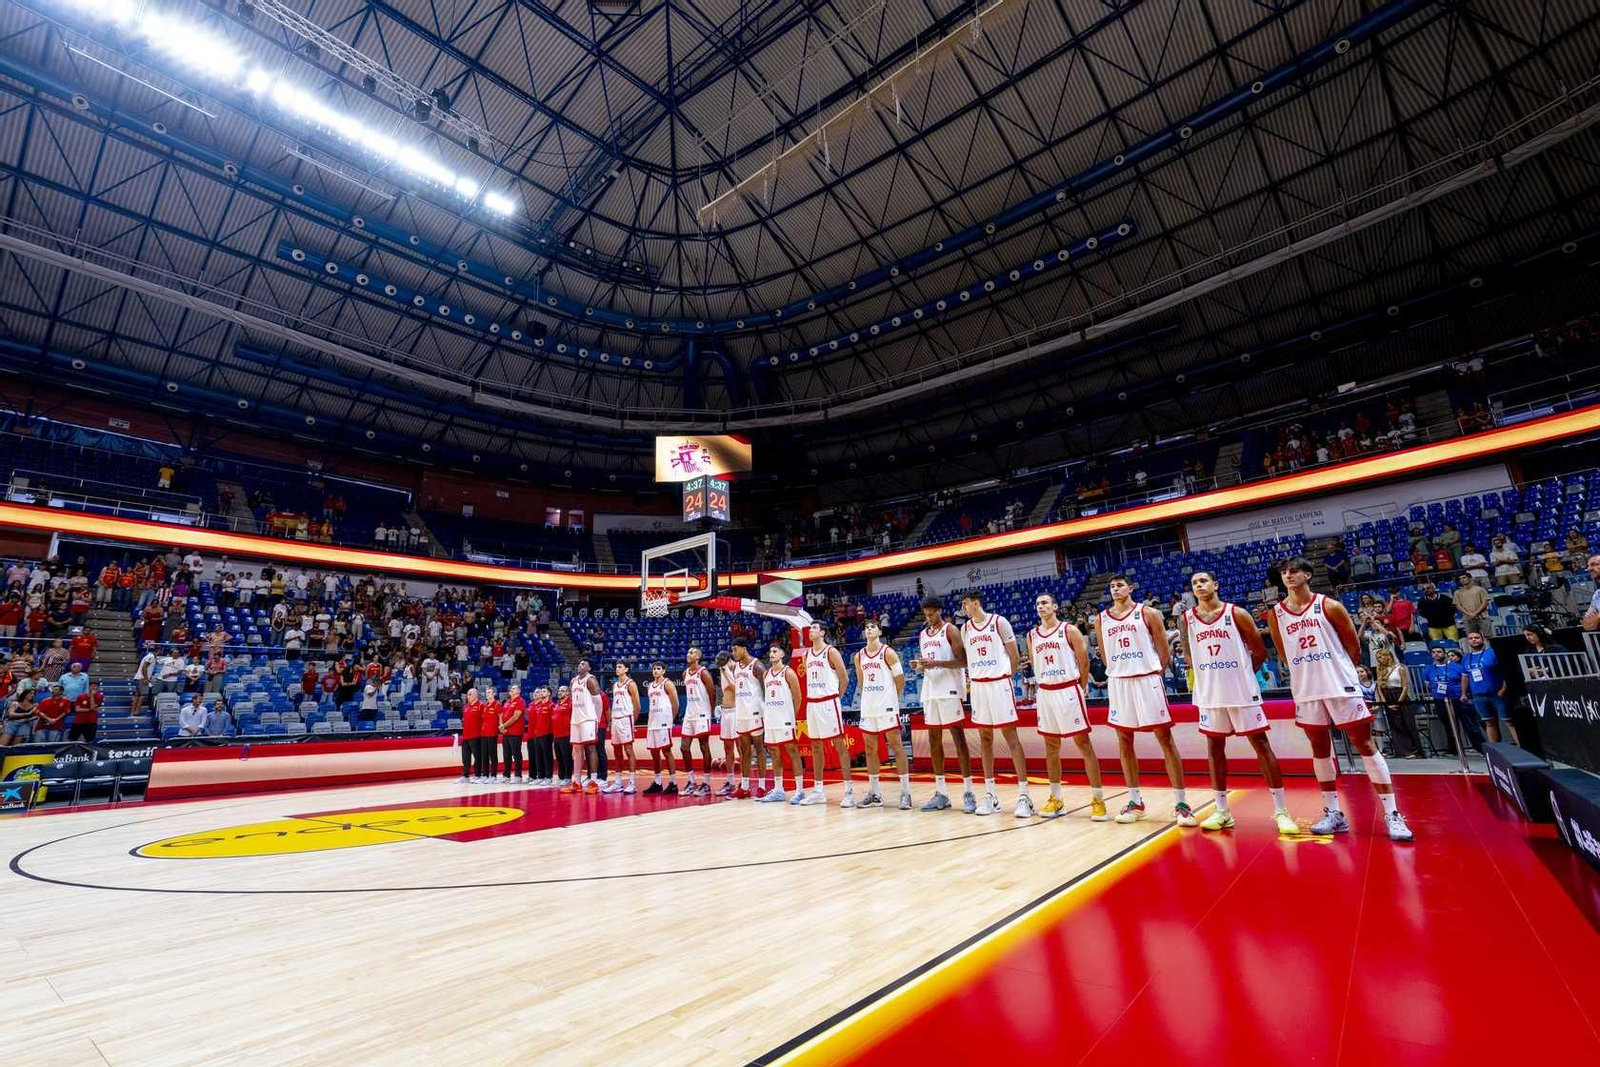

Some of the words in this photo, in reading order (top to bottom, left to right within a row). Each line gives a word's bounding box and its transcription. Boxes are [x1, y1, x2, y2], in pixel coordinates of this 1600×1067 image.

[686, 479, 702, 491] 4:37
[709, 479, 726, 490] 4:37
[686, 492, 702, 512] 24
[710, 492, 726, 511] 24
[1286, 617, 1321, 635] ESPAÑA
[1196, 628, 1231, 643] ESPAÑA
[1118, 637, 1131, 649] 16
[1299, 635, 1317, 650] 22
[976, 646, 987, 657] 15
[1207, 644, 1221, 656] 17
[1044, 655, 1055, 666] 14
[1111, 651, 1143, 662] endesa
[1292, 650, 1332, 666] endesa
[1199, 659, 1239, 671] endesa
[868, 673, 875, 682] 12
[1553, 694, 1584, 719] endesa
[52, 752, 90, 764] xaBank
[108, 747, 158, 760] tenerif
[161, 810, 507, 847] endesa
